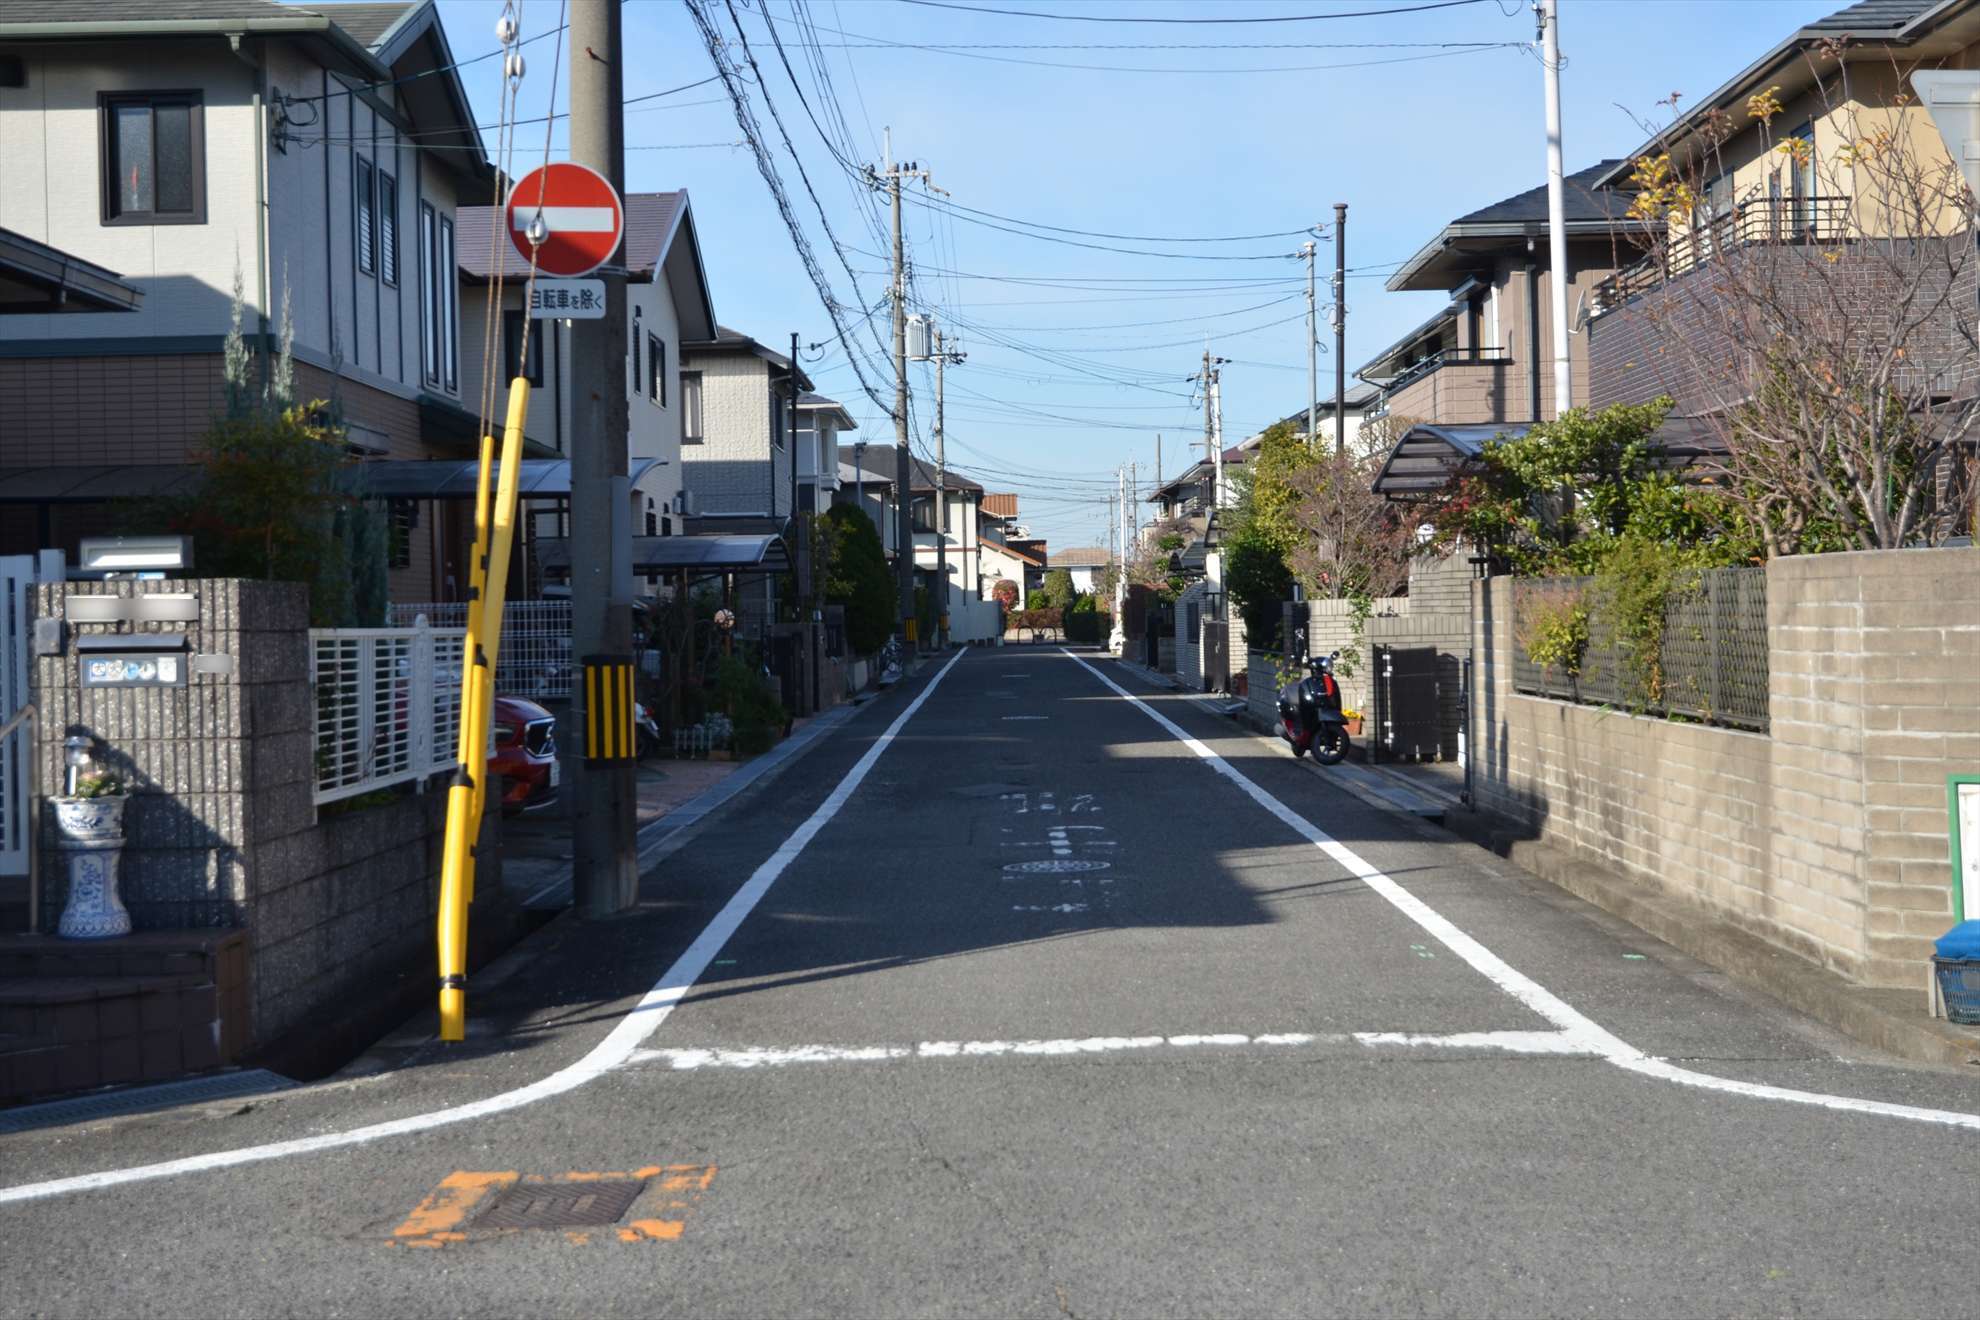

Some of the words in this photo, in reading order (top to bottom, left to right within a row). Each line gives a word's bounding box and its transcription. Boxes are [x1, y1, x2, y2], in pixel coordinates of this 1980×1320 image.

[530, 288, 602, 310] 自転車を除く
